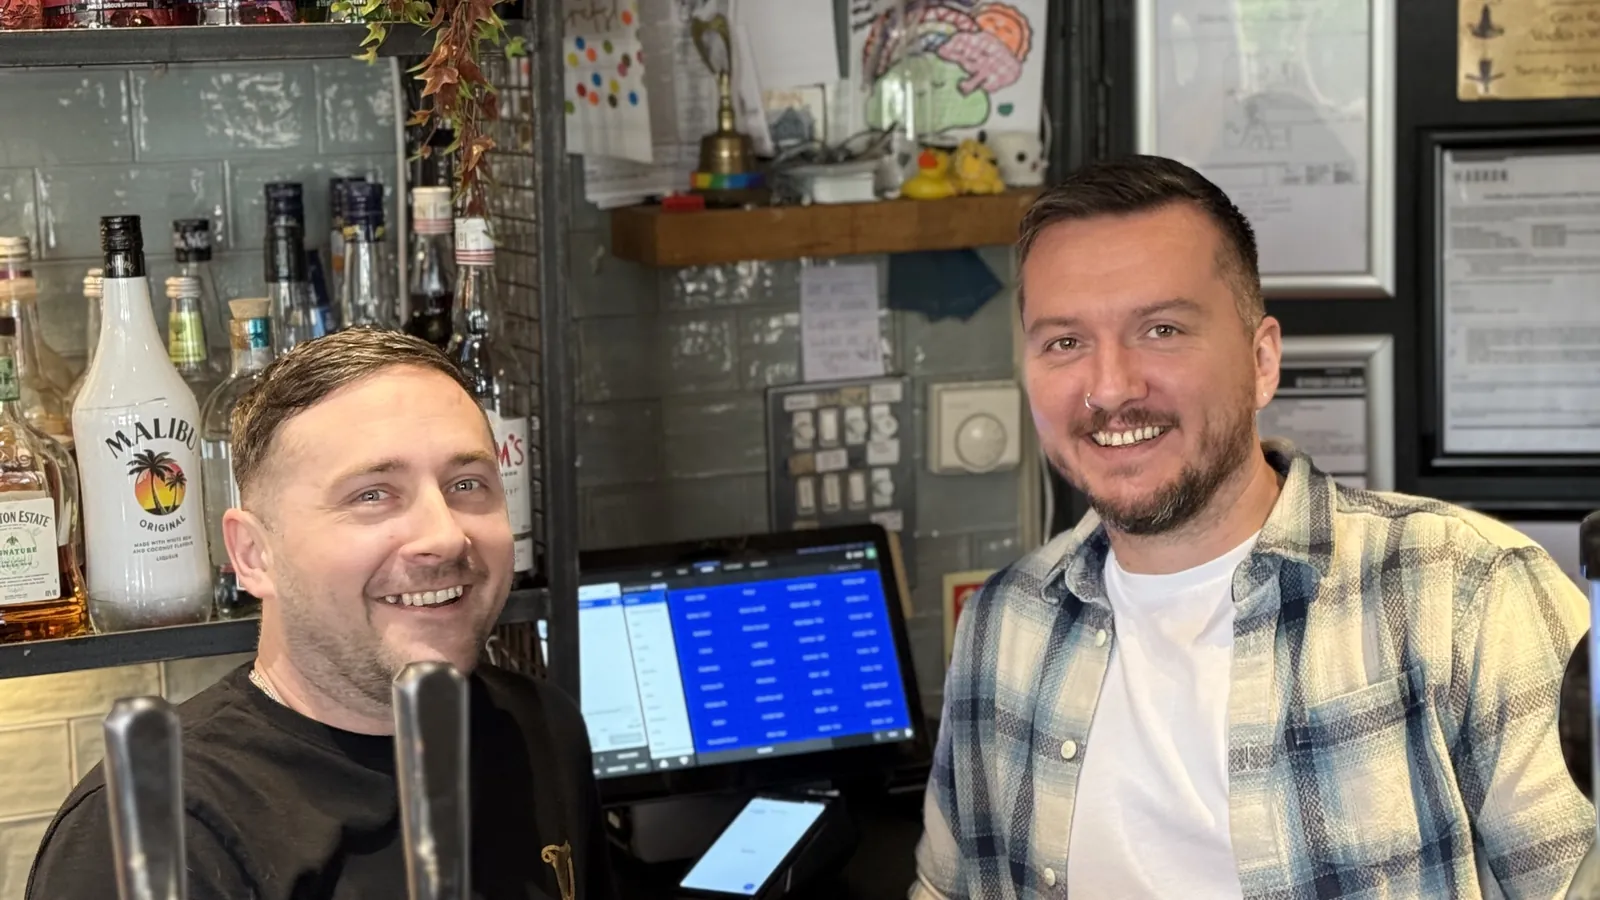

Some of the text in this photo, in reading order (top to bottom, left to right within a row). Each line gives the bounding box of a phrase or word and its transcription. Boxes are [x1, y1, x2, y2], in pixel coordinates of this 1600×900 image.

[105, 417, 197, 460] MALIBU
[19, 510, 50, 528] ESTATE
[139, 515, 186, 532] ORIGINAL
[146, 544, 173, 553] COCONUT
